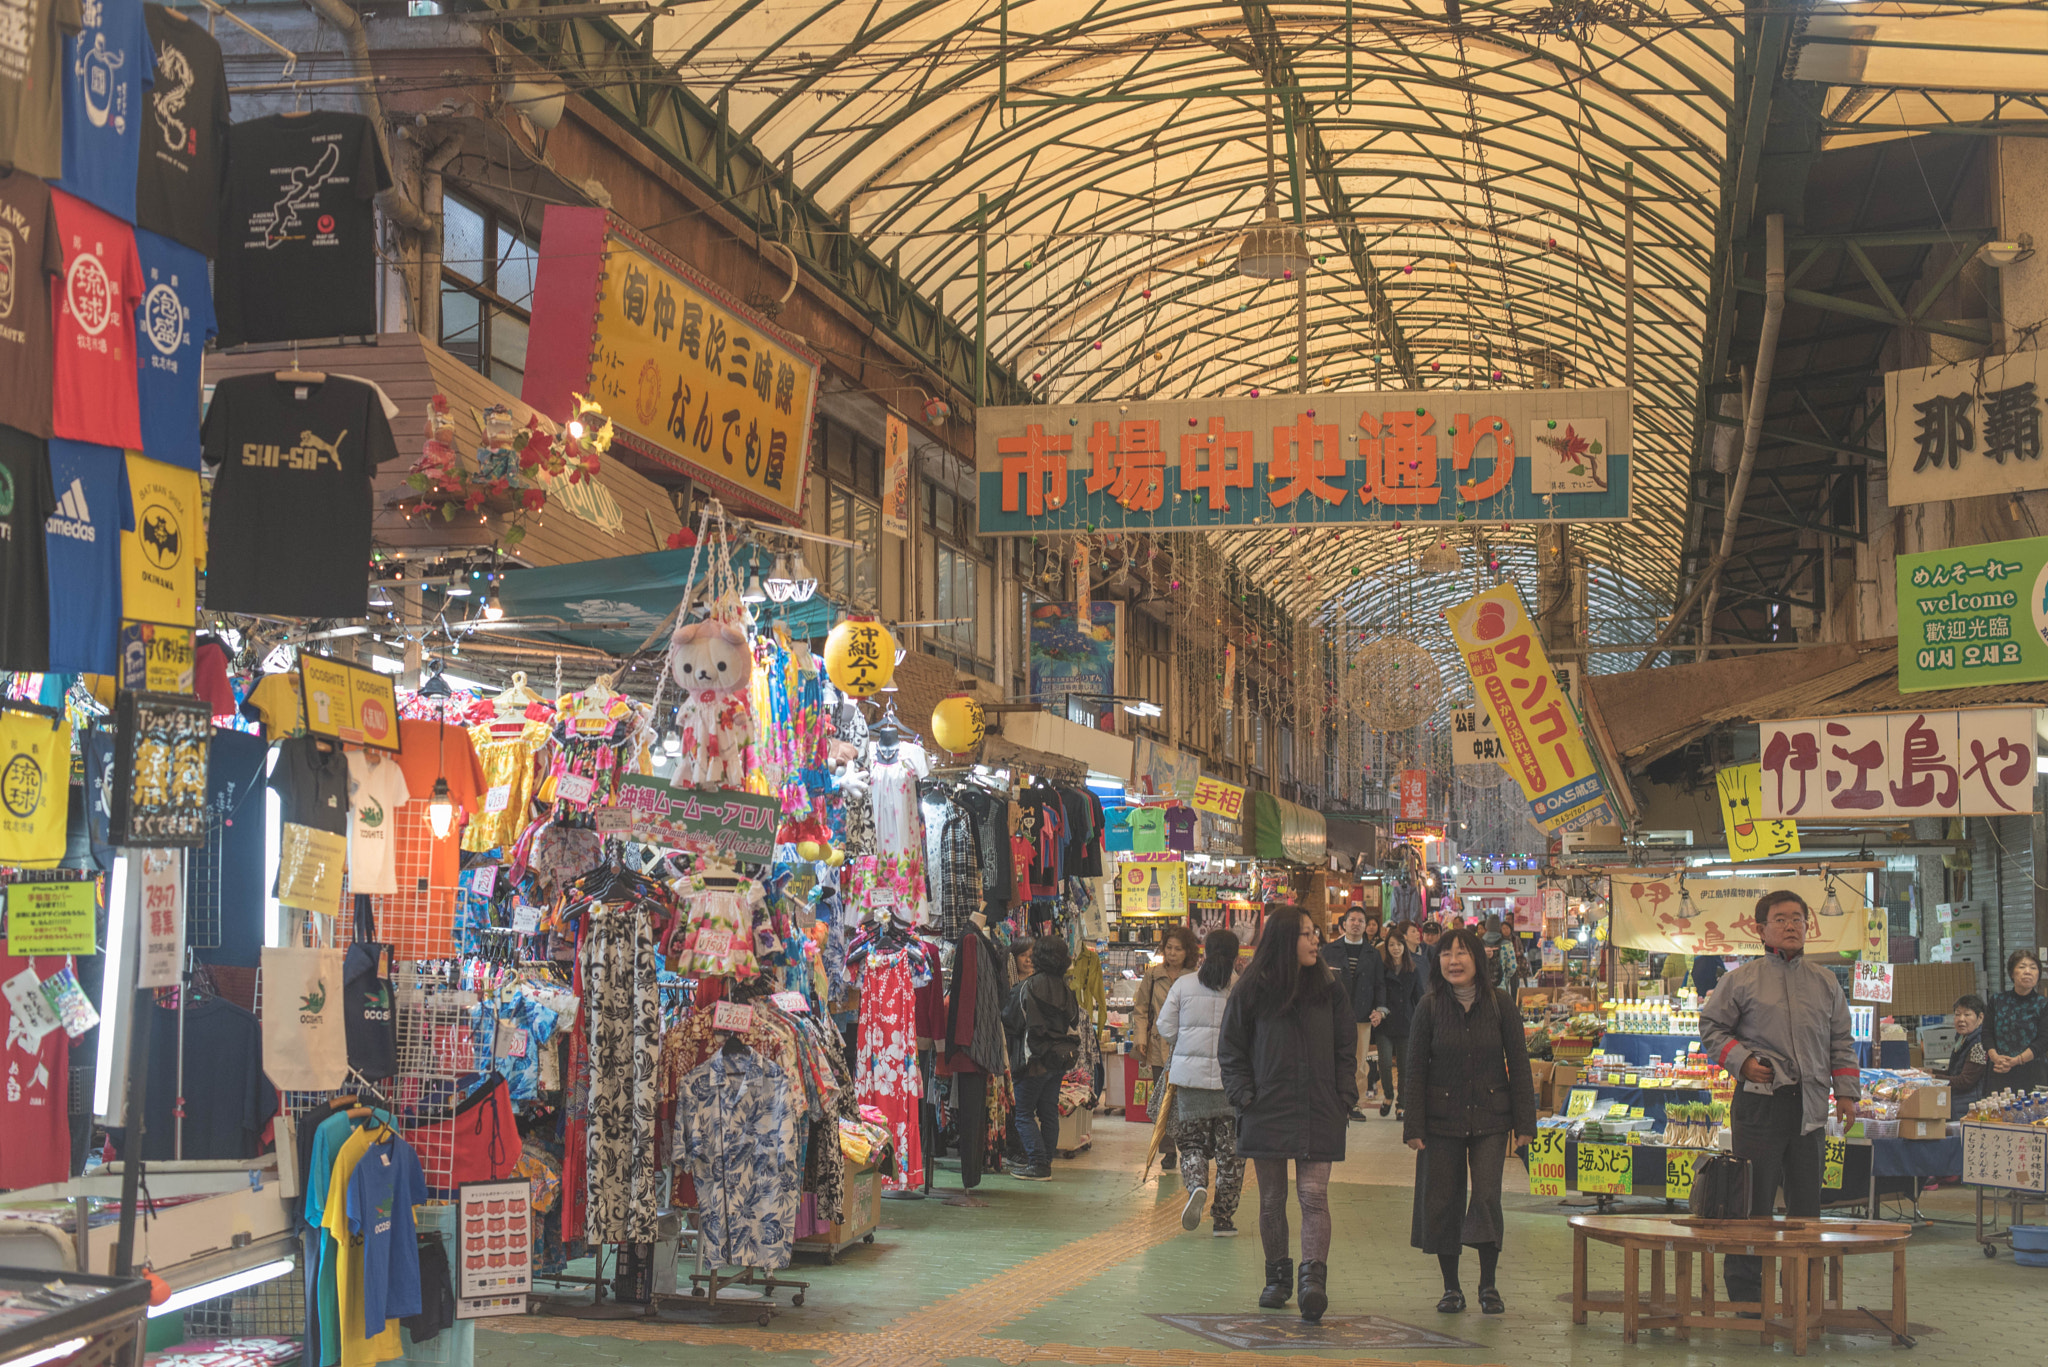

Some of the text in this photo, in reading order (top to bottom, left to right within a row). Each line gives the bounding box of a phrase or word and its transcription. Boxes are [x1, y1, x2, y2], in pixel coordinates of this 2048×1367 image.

[0, 204, 31, 244] AWA
[76, 265, 105, 325] 琉球
[152, 293, 179, 345] 泡盛
[668, 374, 788, 491] なんでも屋
[241, 443, 328, 471] SHI-SA-
[996, 409, 1516, 516] 市場中央通り
[1571, 480, 1594, 489] でいご
[45, 517, 96, 542] amedas
[142, 570, 174, 591] OKINAWA
[1913, 559, 2022, 586] めんそーれー
[1918, 592, 2016, 615] welcome
[1925, 616, 2010, 643] 歡迎光臨
[1917, 642, 2021, 669] 어서 오세요
[1494, 634, 1575, 778] マンゴー
[1763, 714, 2031, 815] 伊江島や
[10, 762, 39, 810] 琉球
[1195, 782, 1242, 814] 手相
[1405, 778, 1424, 819] 泡盛
[1547, 779, 1600, 810] OAS航空
[1466, 875, 1494, 886] 入口
[146, 884, 176, 909] スタッフ
[1531, 1132, 1564, 1154] もずく
[1533, 1163, 1565, 1179] ¥1000
[1578, 1147, 1631, 1174] 海ぶどう
[1534, 1184, 1558, 1196] ¥350
